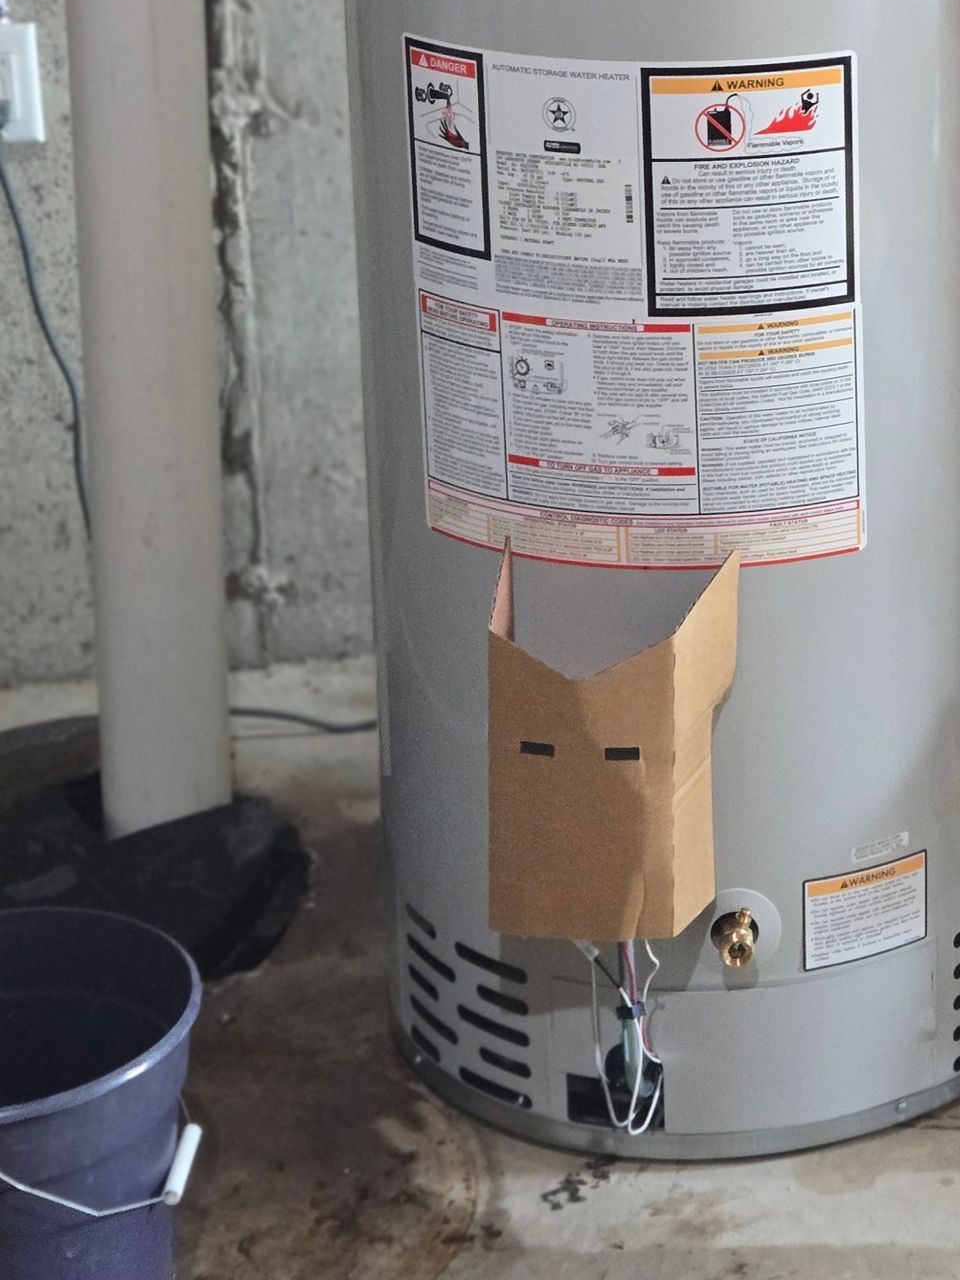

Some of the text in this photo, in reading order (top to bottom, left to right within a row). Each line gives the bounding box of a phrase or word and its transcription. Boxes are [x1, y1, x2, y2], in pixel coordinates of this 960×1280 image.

[430, 58, 467, 74] DANGER
[492, 64, 531, 75] AUTOMATIC
[533, 68, 568, 78] STORAGE
[570, 71, 596, 80] WATER
[727, 78, 784, 90] WARNING
[747, 138, 804, 149] Flammable Vapors
[551, 320, 638, 332] OPERATING INSTRUCTIONS
[767, 320, 799, 329] WARNING
[767, 346, 799, 355] WARNING
[849, 868, 896, 887] WARNING
